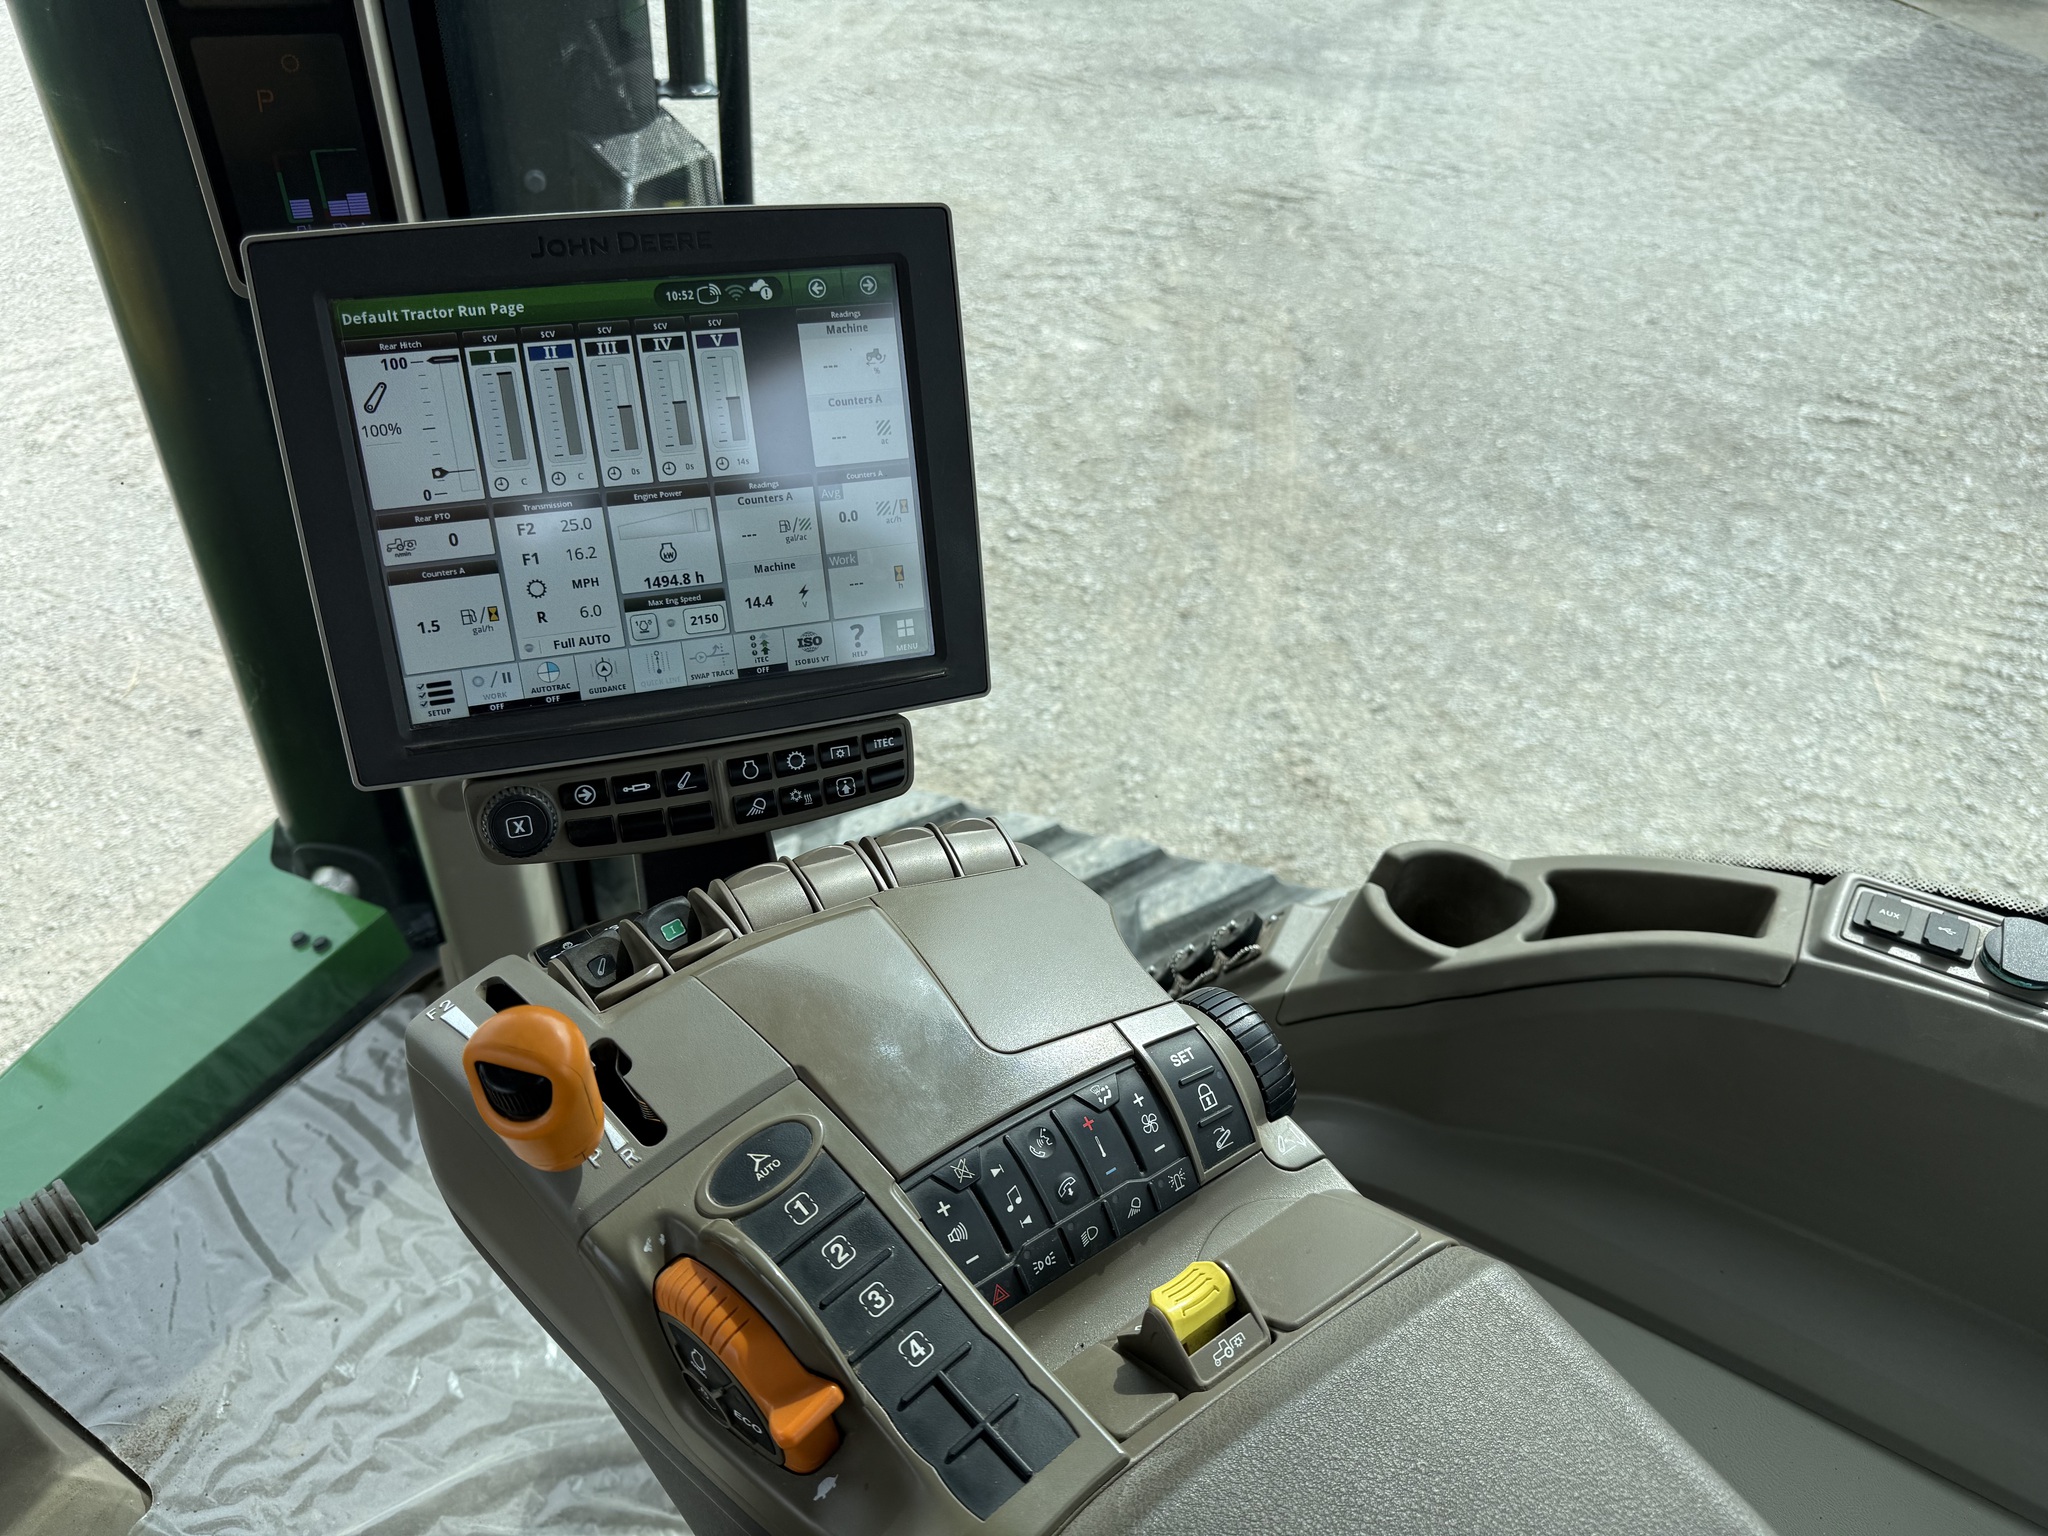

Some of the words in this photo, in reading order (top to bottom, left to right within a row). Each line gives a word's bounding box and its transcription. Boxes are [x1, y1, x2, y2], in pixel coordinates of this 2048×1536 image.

[256, 89, 274, 113] P
[531, 235, 610, 259] JOHN
[617, 231, 713, 254] DEERE
[665, 290, 694, 301] 10:52
[342, 309, 398, 326] Default
[401, 306, 454, 322] Tractor
[458, 304, 486, 317] Run
[490, 302, 525, 318] Page
[830, 310, 861, 320] Readings
[653, 322, 668, 331] SCV
[708, 318, 722, 327] SCV
[540, 330, 556, 339] SCV
[597, 326, 612, 335] SCV
[826, 323, 869, 335] Machine
[482, 334, 498, 343] SCV
[653, 337, 673, 351] IV
[710, 334, 724, 347] V
[379, 342, 398, 351] Rear
[400, 340, 422, 350] Hitch
[596, 342, 618, 355] III
[544, 346, 559, 359] II
[380, 357, 408, 371] 100
[828, 395, 873, 408] Counters
[874, 393, 883, 404] A
[361, 422, 402, 438] 100%
[685, 462, 695, 471] 0s
[736, 457, 750, 466] 14s
[631, 467, 641, 476] 0s
[846, 471, 877, 480] Counters
[748, 480, 779, 490] Readings
[423, 489, 432, 502] 0
[633, 492, 658, 502] Engine
[660, 490, 682, 499] Power
[737, 494, 783, 506] Counters
[786, 492, 793, 501] A
[821, 489, 841, 500] Avg
[523, 501, 573, 512] Transmission
[415, 515, 433, 523] Rear
[434, 513, 451, 522] PTO
[839, 510, 858, 523] 0.0
[517, 523, 536, 536] F2
[560, 518, 592, 533] 25.0
[449, 533, 459, 547] 0
[785, 534, 807, 544] gal/ac
[522, 553, 540, 566] F1
[566, 546, 598, 562] 16.2
[663, 551, 674, 560] kW
[829, 554, 856, 566] Work
[422, 569, 457, 578] Counters
[459, 567, 465, 575] A
[754, 562, 796, 574] Machine
[572, 577, 600, 589] MPH
[644, 573, 691, 589] 1494.8
[695, 571, 705, 584] h
[648, 599, 663, 607] Max
[665, 597, 679, 605] Eng
[680, 594, 702, 604] Speed
[745, 595, 774, 609] 14.4
[536, 611, 548, 624] R
[580, 604, 602, 618] 6.0
[690, 613, 719, 626] 2150
[417, 620, 441, 634] 1.5
[472, 625, 494, 636] gal/h
[553, 638, 575, 650] Full
[578, 634, 611, 647] AUTO
[797, 636, 823, 649] ISO
[896, 643, 919, 652] MENU
[754, 656, 769, 664] iTEC
[852, 650, 868, 658] HELP
[795, 658, 820, 667] ISOBUS
[690, 673, 710, 681] SWAP
[711, 669, 735, 678] TRACK
[756, 667, 770, 675] OFF
[531, 683, 571, 694] AUTOTRAC
[588, 683, 627, 695] GUIDANCE
[483, 691, 508, 700] WORK
[545, 695, 560, 704] OFF
[428, 708, 451, 718] SETUP
[489, 703, 505, 712] OFF
[874, 736, 895, 749] iTEC
[512, 819, 526, 834] X
[1879, 908, 1901, 920] AUX
[1170, 1047, 1194, 1067] SET
[617, 1149, 642, 1169] R
[755, 1158, 781, 1181] AUTO
[794, 1200, 810, 1217] 1
[830, 1243, 850, 1263] 2
[867, 1290, 886, 1309] 3
[908, 1339, 926, 1359] 4
[733, 1409, 763, 1434] ECO
